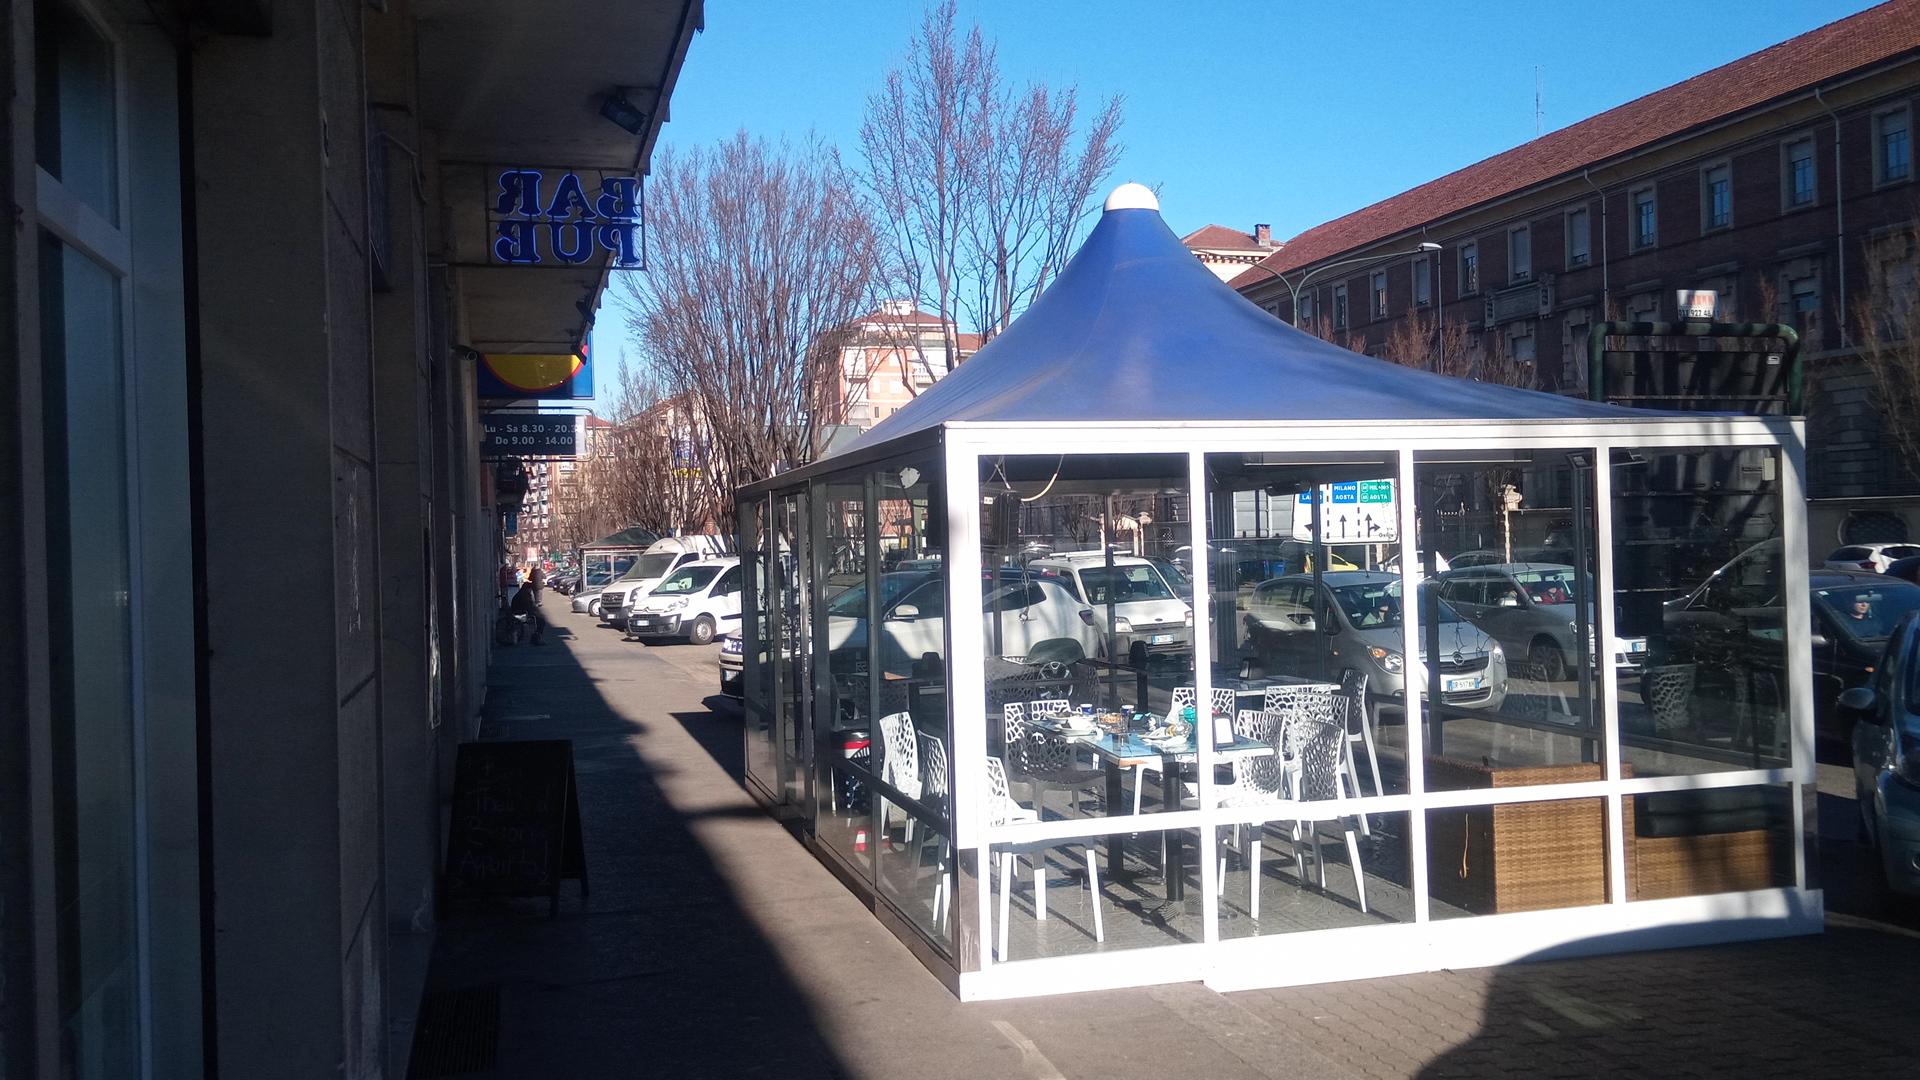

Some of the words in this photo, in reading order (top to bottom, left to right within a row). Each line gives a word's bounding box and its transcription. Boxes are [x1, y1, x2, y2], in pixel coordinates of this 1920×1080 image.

[484, 424, 496, 432] Lu
[506, 424, 518, 432] Sa
[522, 424, 544, 432] 8.30
[495, 436, 508, 444] Do
[512, 436, 534, 444] 9.00
[545, 436, 573, 444] 14.00
